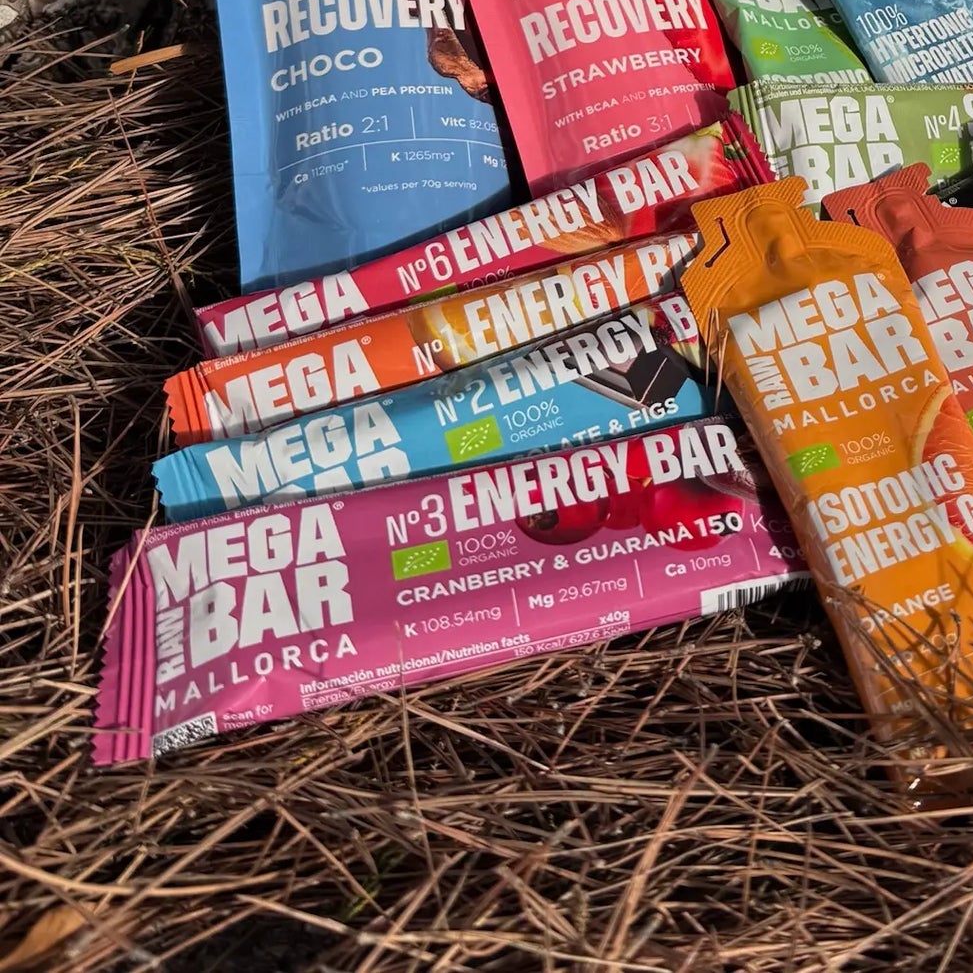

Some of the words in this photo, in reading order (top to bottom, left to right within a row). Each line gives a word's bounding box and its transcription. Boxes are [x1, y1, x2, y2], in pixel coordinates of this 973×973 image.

[856, 4, 909, 38] 100%
[271, 47, 384, 92] CHOCO
[541, 48, 702, 101] STRAWBERRY
[785, 43, 824, 58] 100%
[275, 104, 303, 123] WITH
[304, 93, 338, 112] BCAA
[341, 88, 369, 102] AND
[372, 86, 396, 97] PEA
[400, 85, 454, 96] PROTEIN
[554, 110, 585, 130] WITH
[585, 97, 620, 116] BCAA
[621, 90, 648, 105] AND
[648, 86, 670, 99] PEA
[672, 82, 716, 94] PROTEIN
[758, 95, 900, 155] MEGA
[295, 121, 355, 152] Ratio
[361, 114, 390, 135] 2:1
[440, 116, 467, 129] VitC
[581, 123, 642, 155] Ratio
[646, 113, 673, 134] 3:1
[294, 172, 309, 185] Ca
[391, 151, 401, 162] K
[483, 154, 499, 169] Mg
[401, 180, 419, 191] per
[421, 179, 442, 190] 70g
[444, 179, 478, 191] serving
[445, 175, 605, 275] ENERGY
[606, 149, 700, 216] BAR
[203, 270, 371, 358] MEGA
[462, 254, 631, 356] ENERGY
[726, 272, 903, 359] MEGA
[486, 309, 659, 407] ENERGY
[744, 355, 795, 412] RAW
[778, 312, 930, 404] BAR
[204, 338, 382, 445] MEGA
[503, 398, 561, 431] 100%
[608, 418, 625, 435] &
[627, 396, 680, 430] FIGS
[772, 368, 942, 436] MALLORCA
[205, 401, 403, 511] MEGA
[510, 416, 565, 444] ORGANIC
[840, 430, 892, 456] 100%
[846, 444, 897, 466] ORGANIC
[448, 441, 632, 533] ENERGY
[642, 424, 747, 487] BAR
[806, 453, 966, 542] ISOTONIC
[146, 502, 348, 611] MEGA
[396, 558, 547, 607] CRANBERRY
[553, 554, 570, 570] &
[573, 523, 693, 566] GUARANÀ
[693, 512, 743, 538] 150
[455, 530, 518, 556] 100%
[458, 546, 520, 567] ORGANIC
[824, 501, 957, 587] ENERGY
[154, 605, 187, 686] RAW
[188, 558, 356, 670] BAR
[403, 622, 419, 638] K
[420, 604, 503, 636] 108.54mg
[528, 592, 555, 610] Mg
[557, 575, 629, 603] 29.67mg
[664, 561, 688, 578] Ca
[689, 553, 732, 572] 10mg
[858, 583, 956, 636] ORANGE
[299, 667, 375, 696] Información
[500, 632, 531, 650] facts
[599, 610, 631, 626] x40g
[568, 630, 602, 645] 627.6
[153, 632, 359, 719] MALLORCA
[255, 703, 275, 717] for
